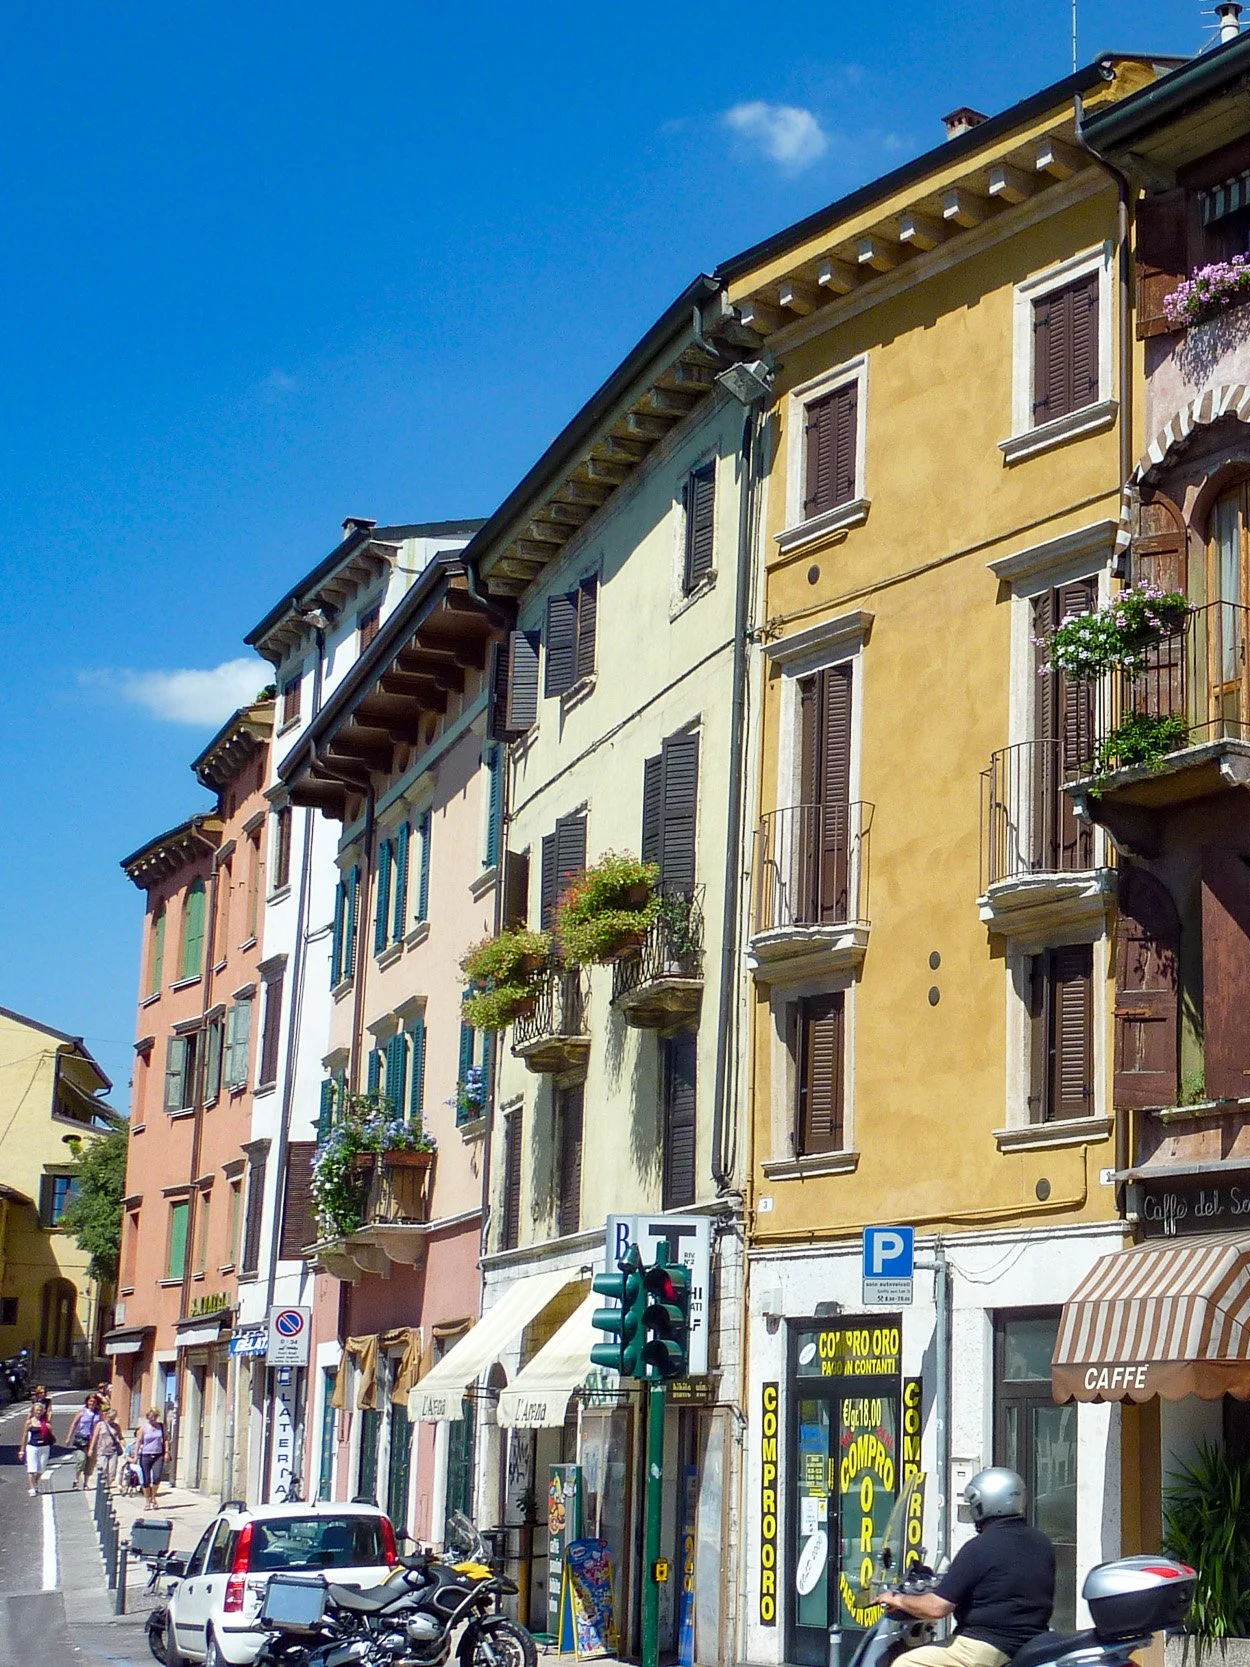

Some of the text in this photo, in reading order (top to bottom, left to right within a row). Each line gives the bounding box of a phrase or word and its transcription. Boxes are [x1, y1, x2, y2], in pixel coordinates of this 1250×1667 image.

[873, 1231, 905, 1274] P
[819, 1329, 870, 1358] COMPRO
[872, 1328, 899, 1356] ORO
[821, 1358, 896, 1376] PAGO IN CONTANTI
[515, 1398, 547, 1421] L'Arena
[840, 1434, 894, 1494] COMPRO
[760, 1386, 777, 1621] COMPRO ORO
[860, 1476, 874, 1588] ORO
